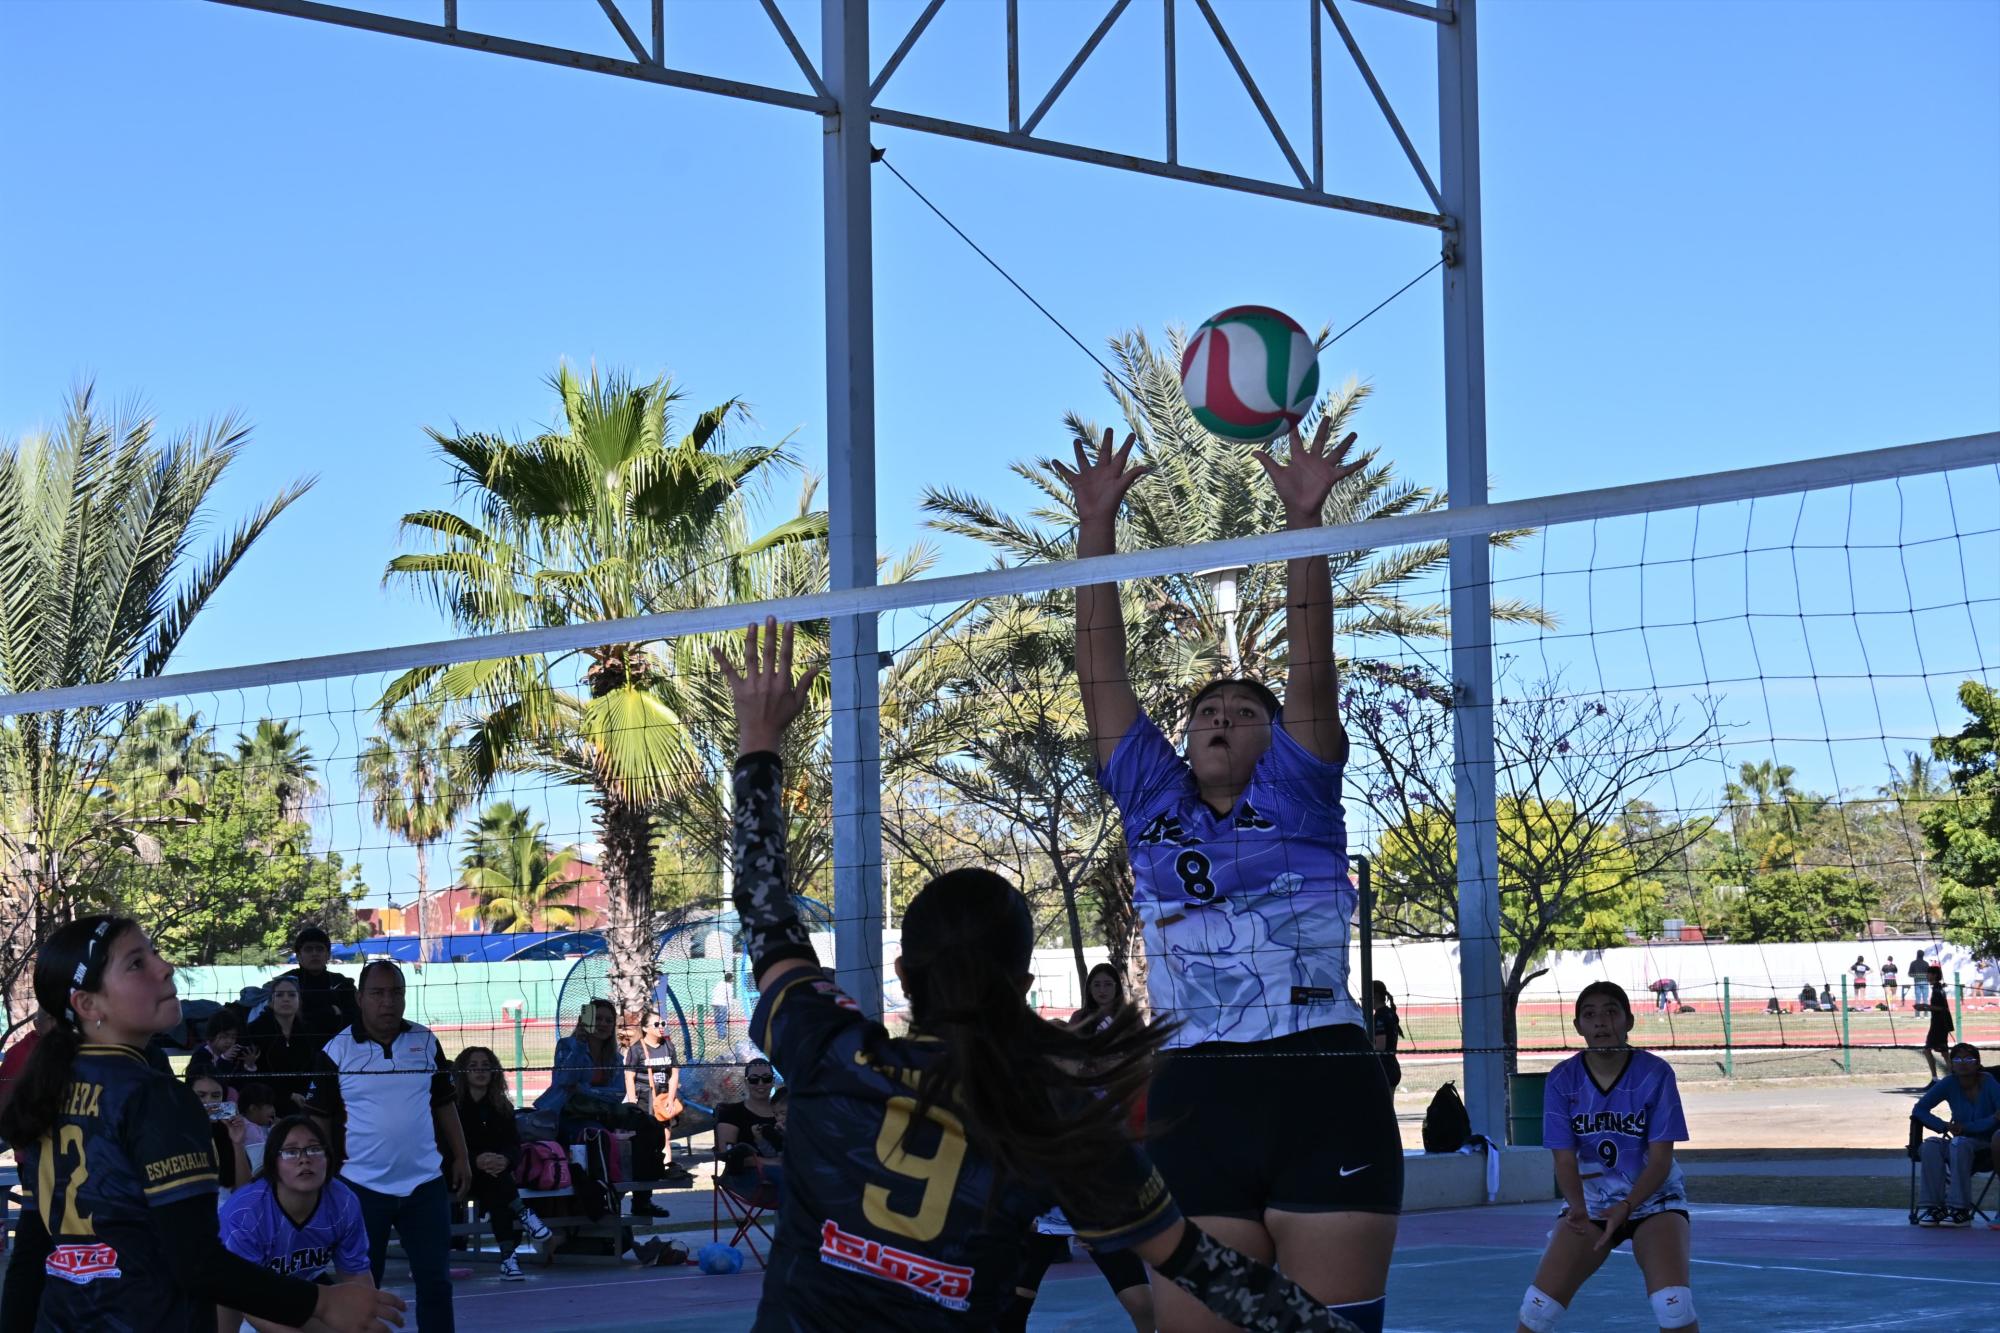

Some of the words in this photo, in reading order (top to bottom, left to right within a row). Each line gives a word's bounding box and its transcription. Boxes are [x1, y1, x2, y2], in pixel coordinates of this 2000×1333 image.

[1176, 848, 1217, 902] 8
[1570, 1108, 1647, 1139] ELFINES
[38, 1121, 97, 1237] 12
[862, 1096, 969, 1242] 9
[1596, 1138, 1619, 1168] 9
